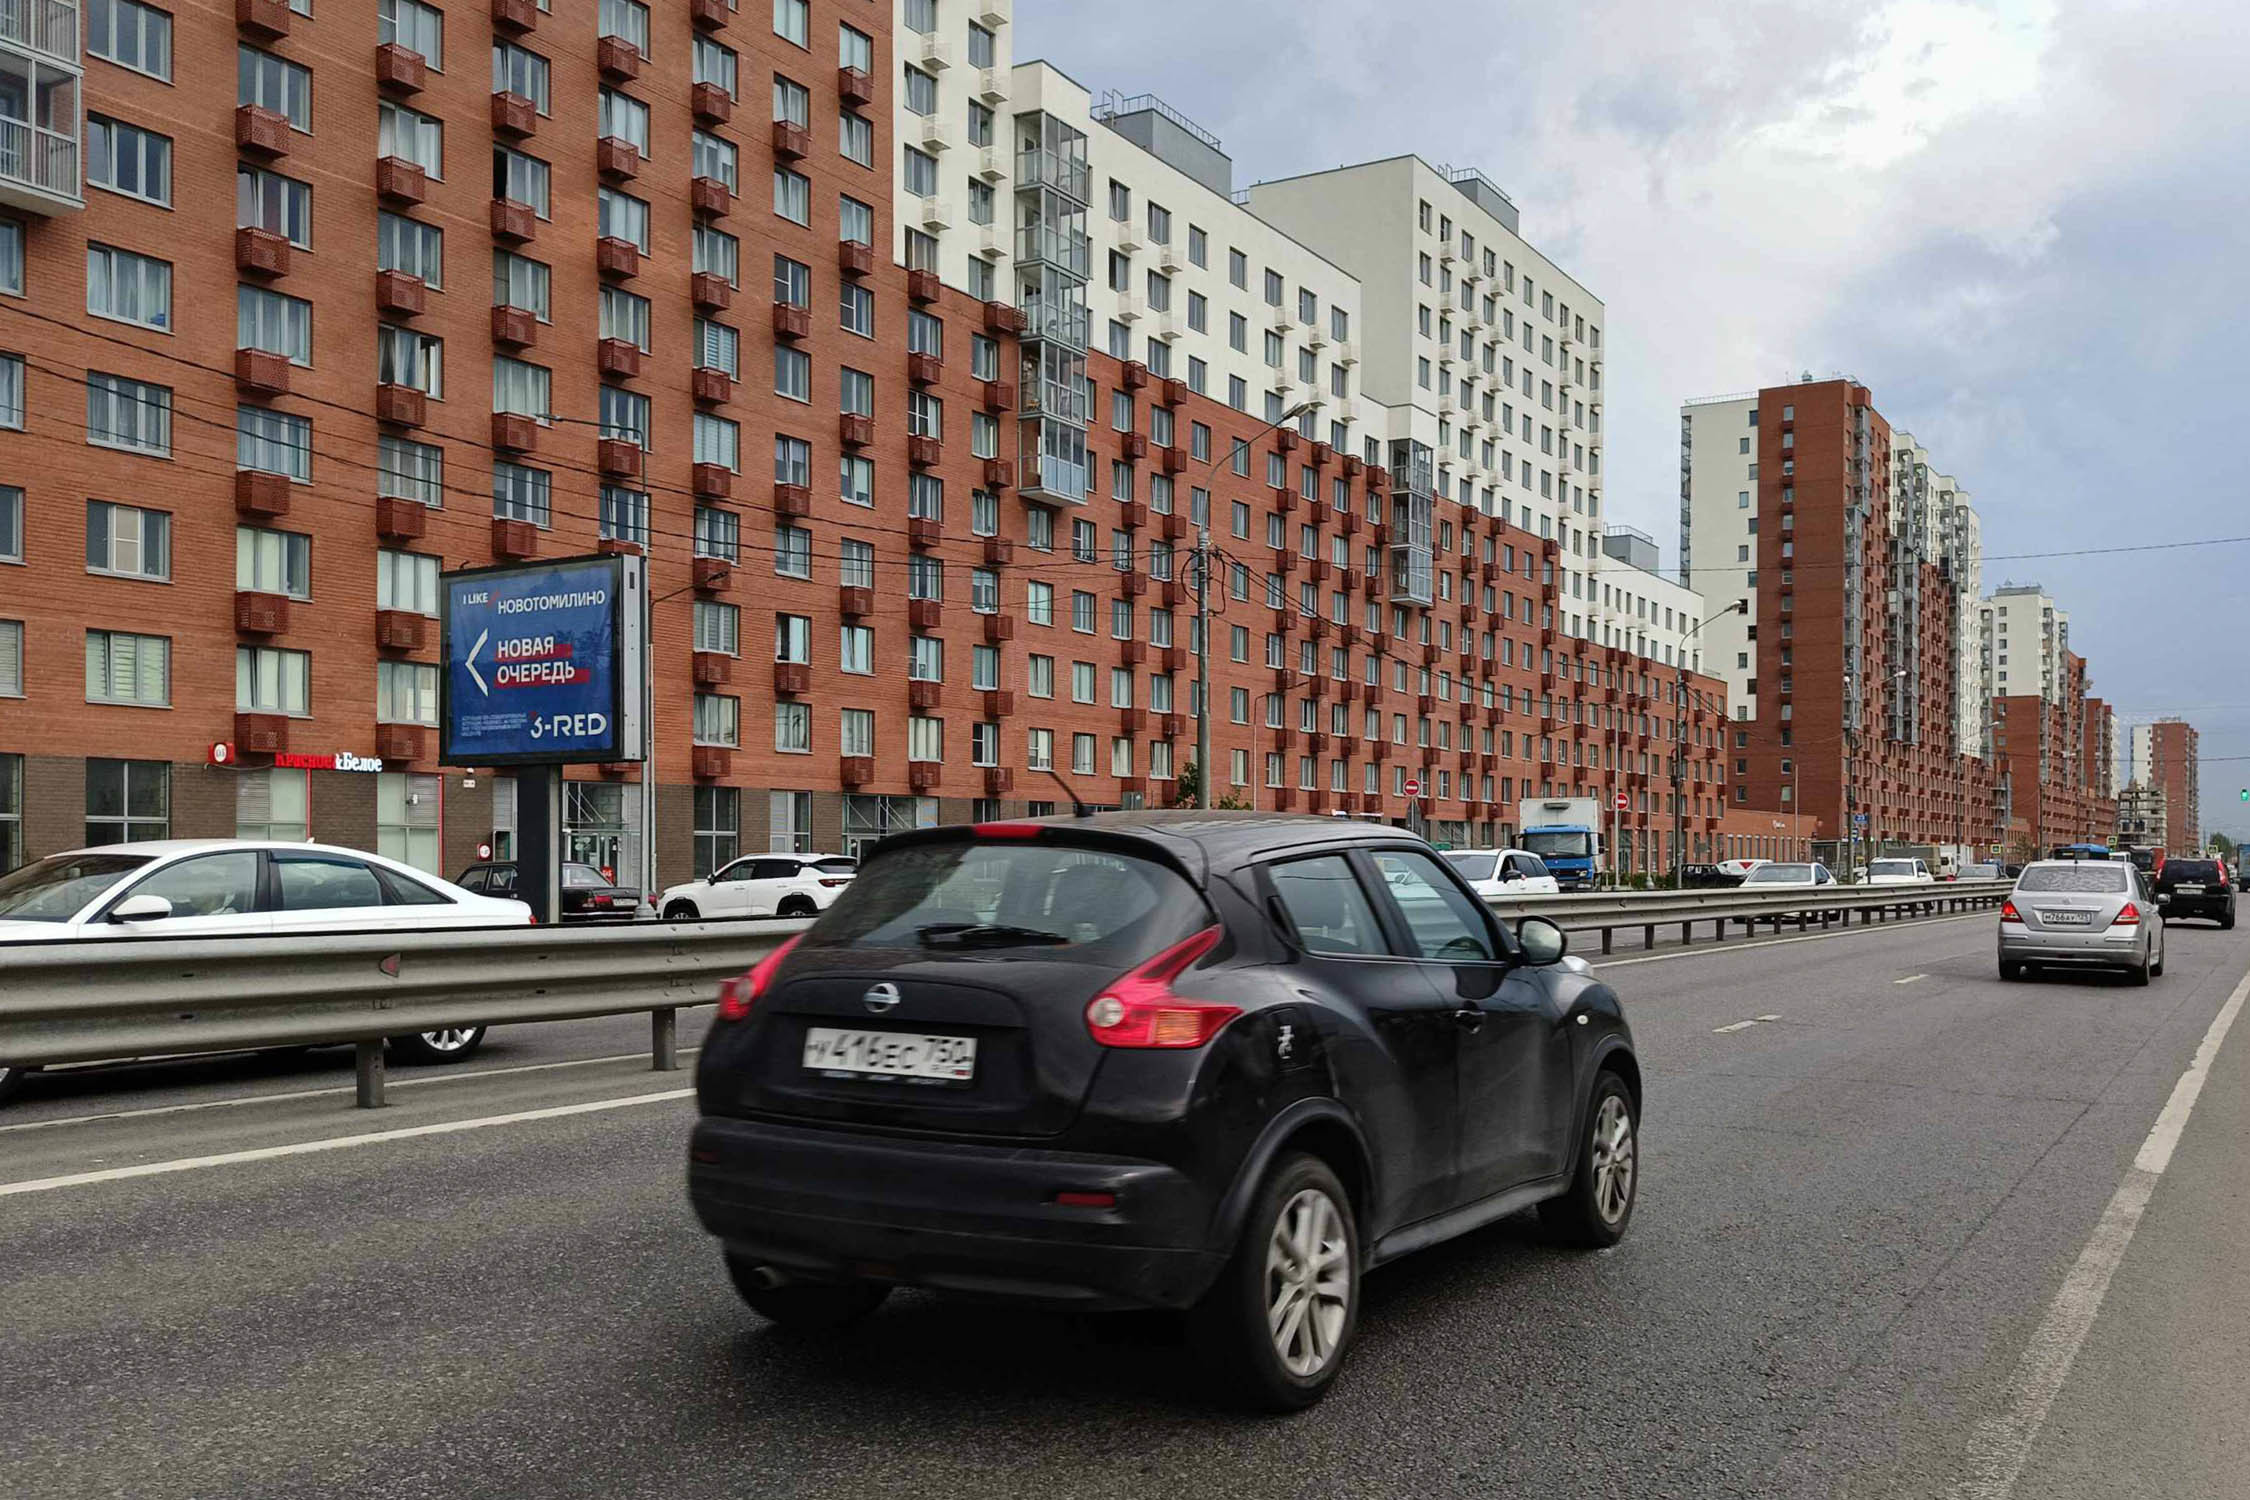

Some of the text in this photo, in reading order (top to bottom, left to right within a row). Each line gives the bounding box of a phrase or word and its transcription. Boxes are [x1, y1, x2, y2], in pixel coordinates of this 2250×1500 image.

[468, 592, 488, 605] LIKE
[498, 590, 605, 615] НОВОТОМИЛИНО
[498, 636, 554, 658] НОВАЯ
[497, 661, 575, 684] ОЧЕРЕДЬ
